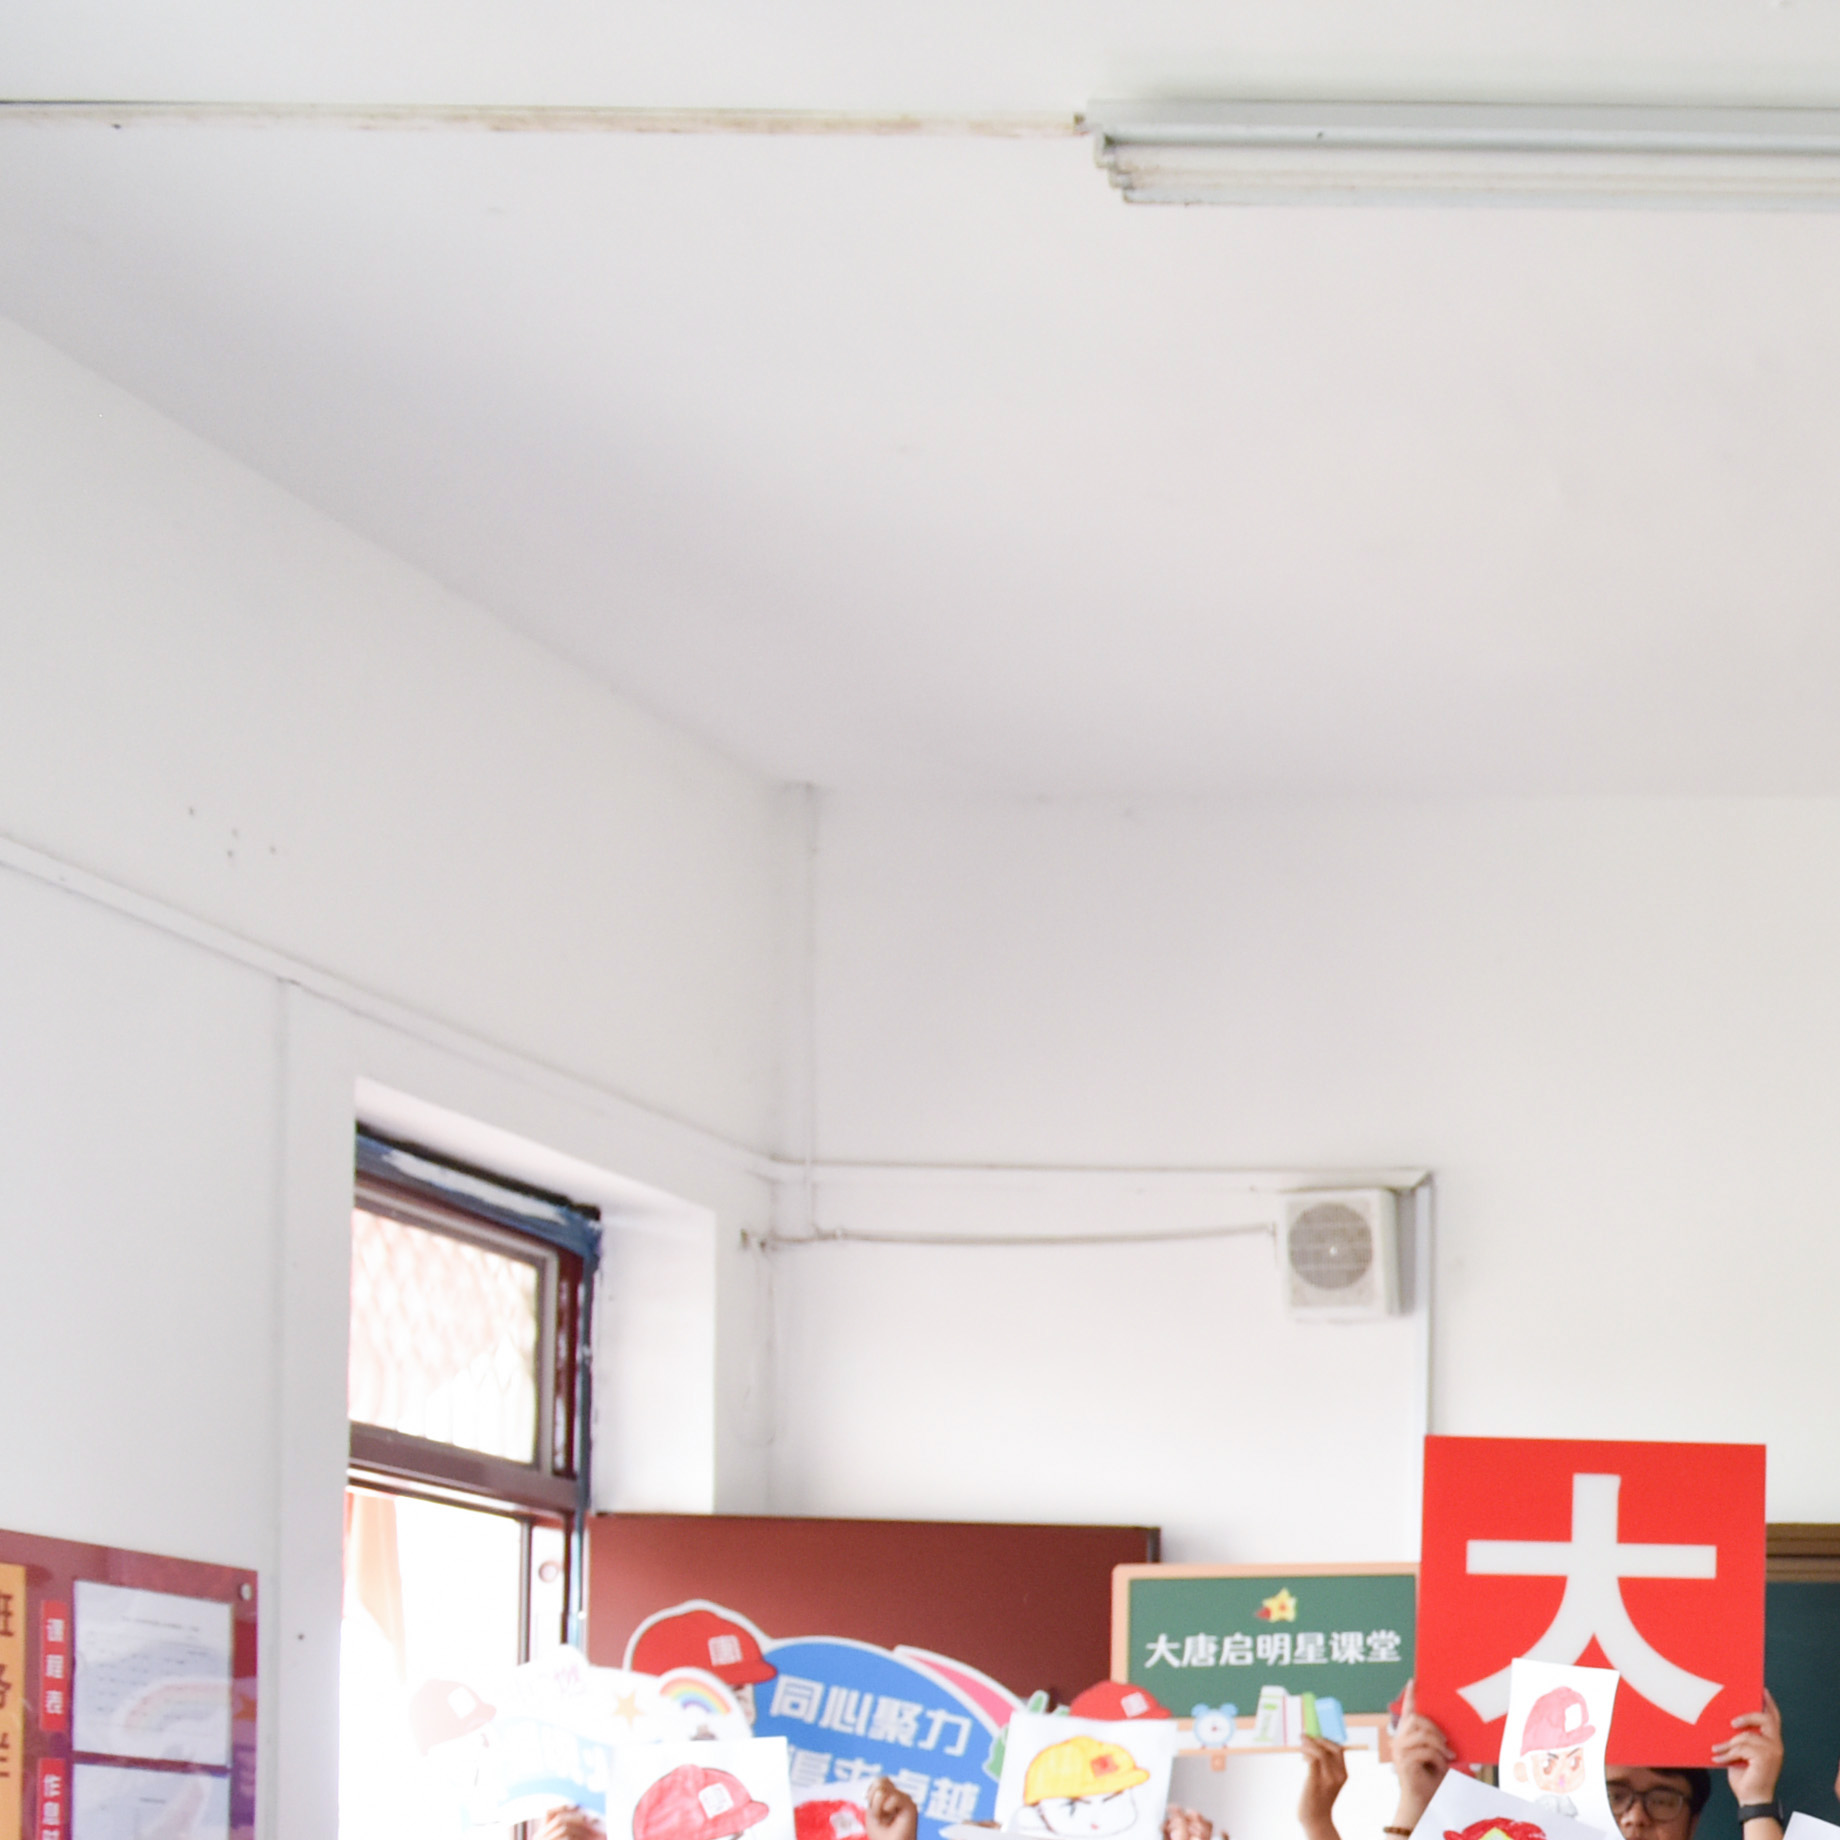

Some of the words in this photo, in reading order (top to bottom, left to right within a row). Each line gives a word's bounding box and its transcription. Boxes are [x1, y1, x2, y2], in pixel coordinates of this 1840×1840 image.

[1457, 1473, 1723, 1725] 大
[1144, 1629, 1402, 1668] 大唐启明星课堂
[769, 1674, 972, 1757] 同心聚力
